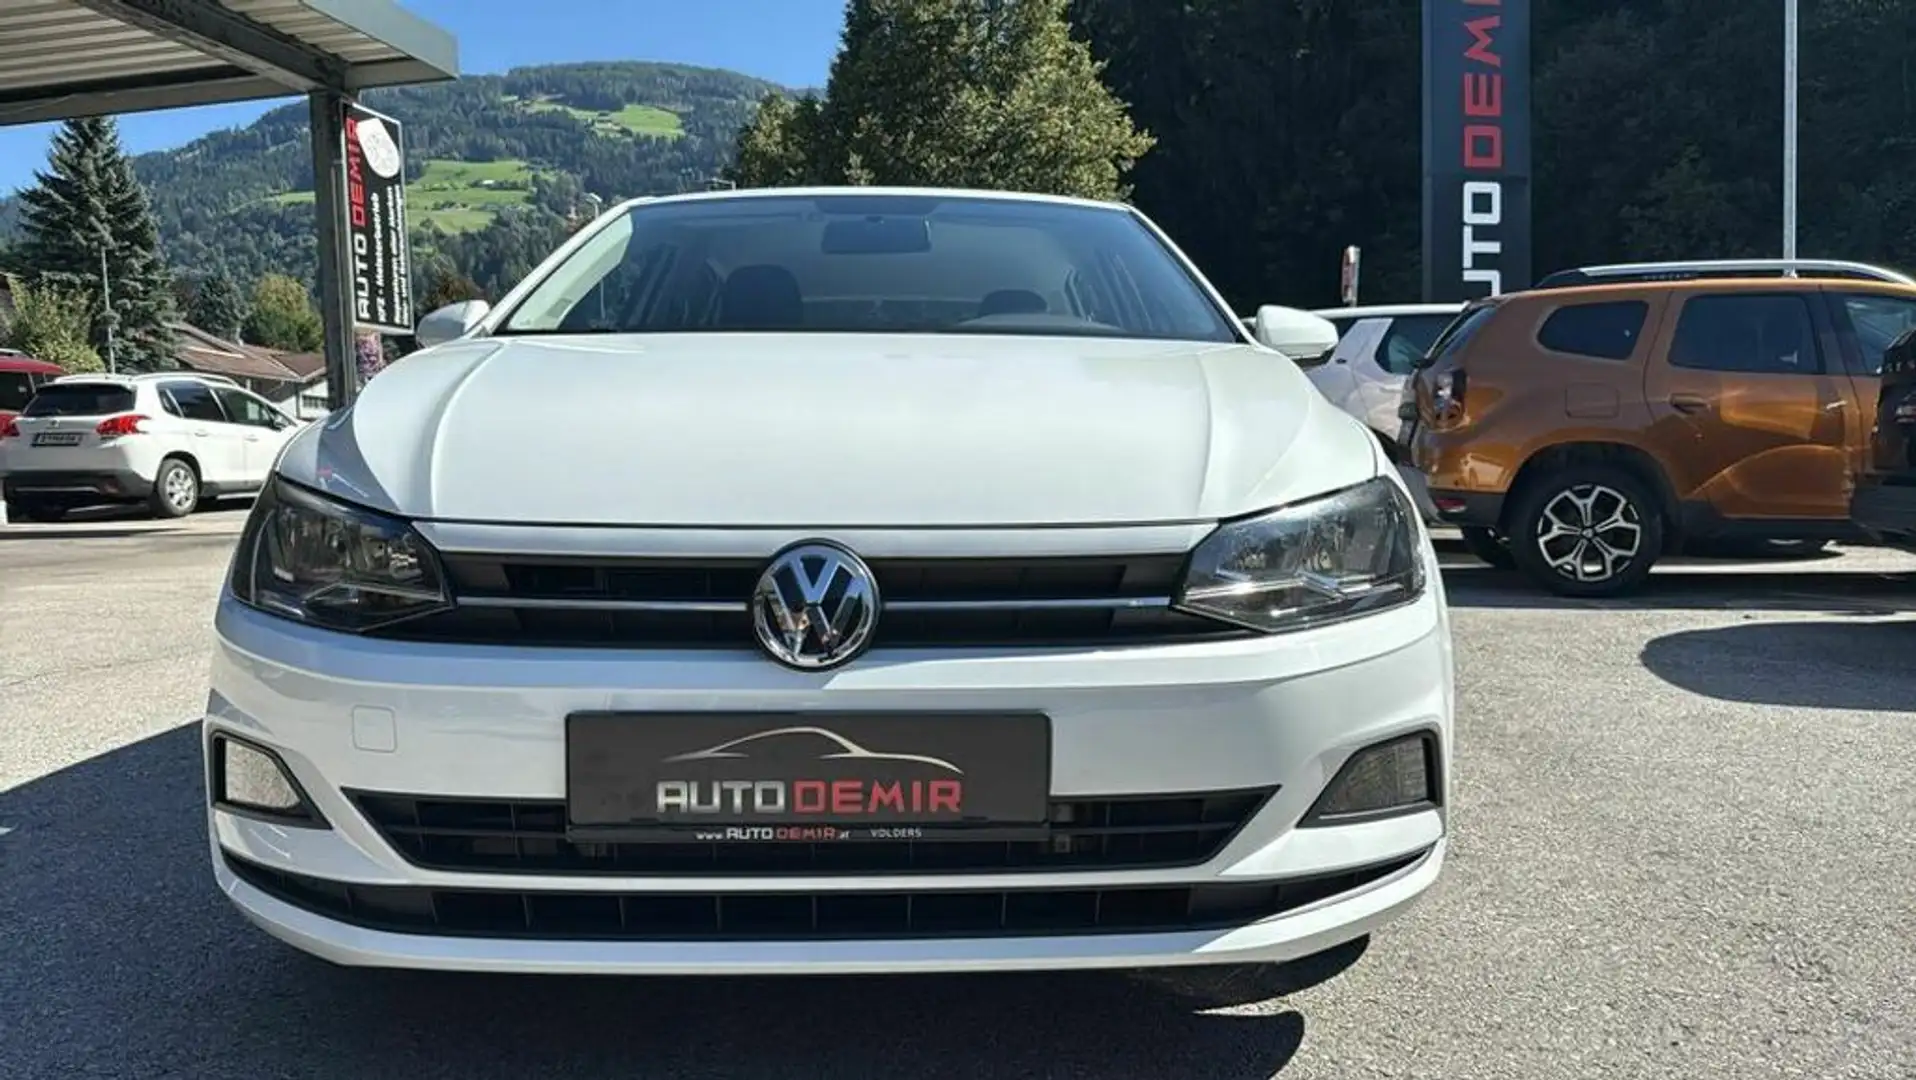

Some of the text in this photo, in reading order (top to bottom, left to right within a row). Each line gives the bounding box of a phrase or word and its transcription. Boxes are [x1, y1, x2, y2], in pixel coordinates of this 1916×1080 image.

[346, 117, 371, 320] AUTO DEMIR
[1462, 181, 1501, 297] UTO
[870, 828, 922, 838] VOLDERS
